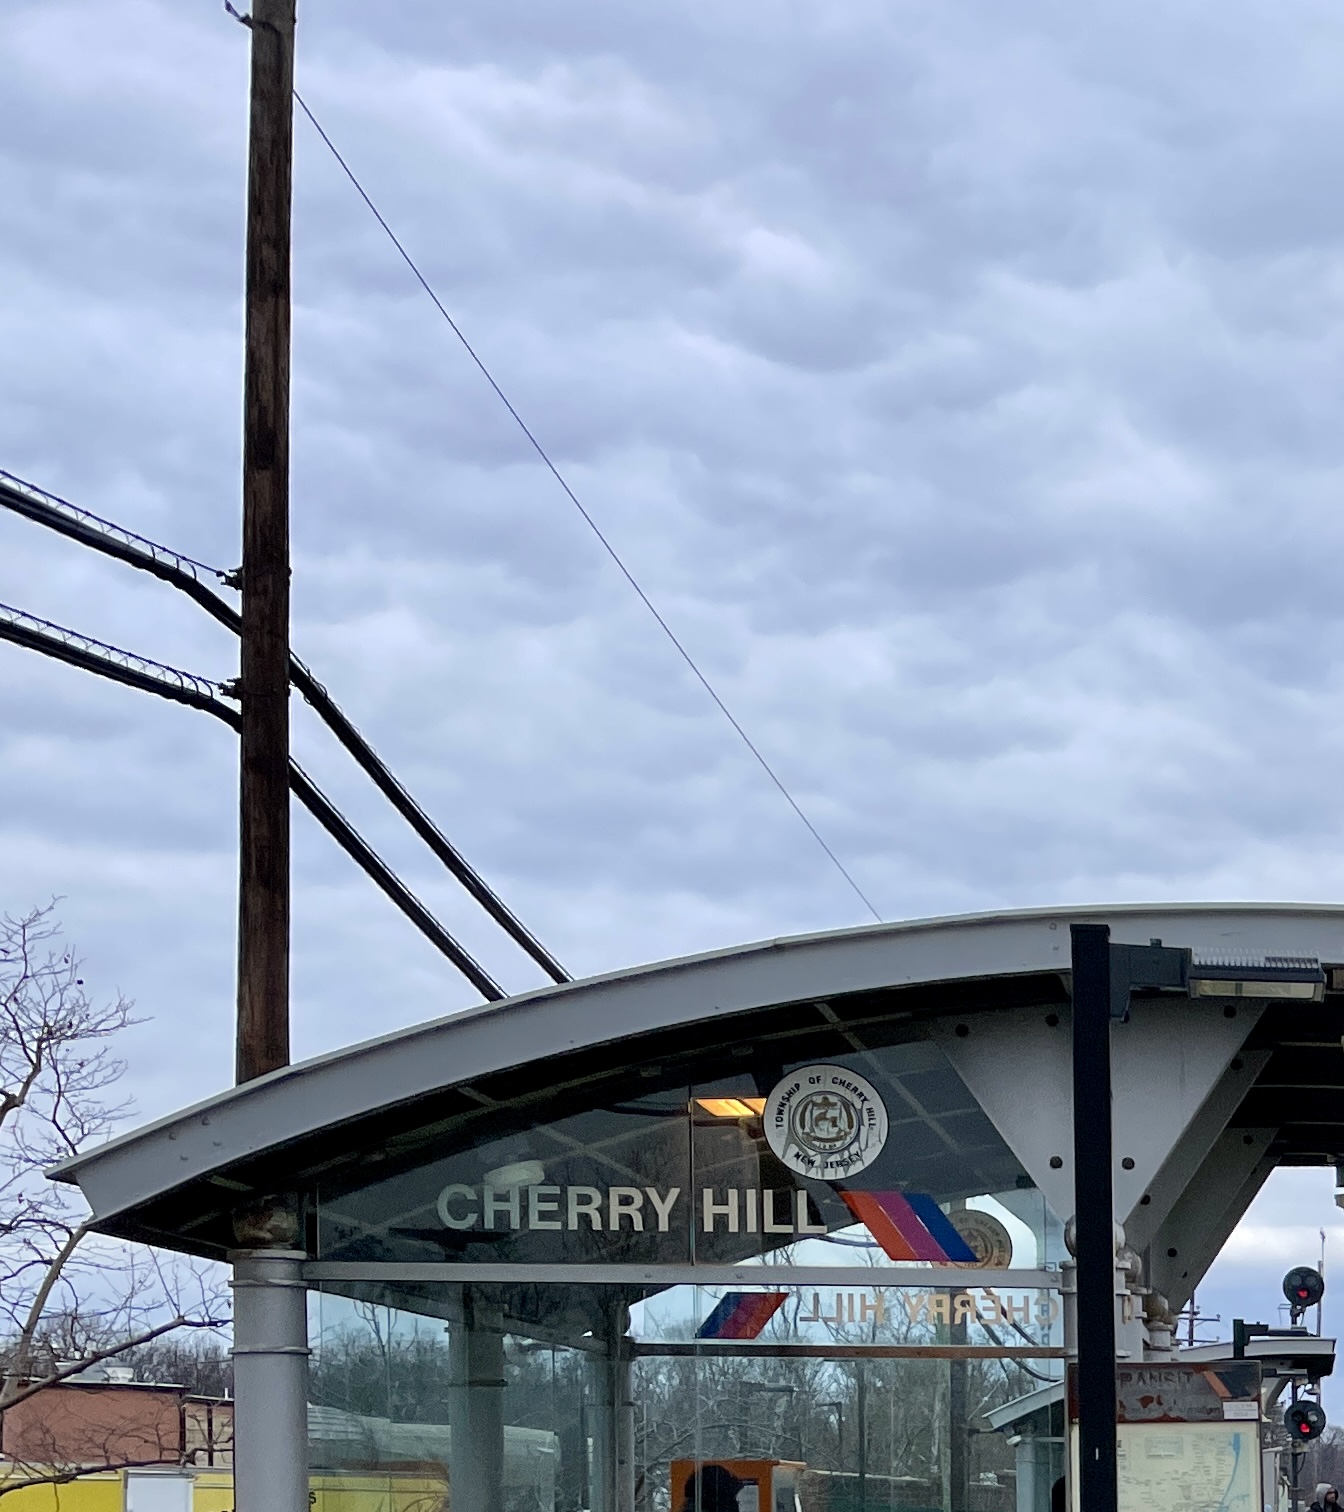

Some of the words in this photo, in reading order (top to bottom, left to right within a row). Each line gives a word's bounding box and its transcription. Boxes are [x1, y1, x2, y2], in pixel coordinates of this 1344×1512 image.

[775, 1083, 801, 1129] TOWNSHIP
[808, 1075, 822, 1085] OF
[831, 1077, 871, 1102] CHERRY
[793, 1151, 816, 1167] NEW
[824, 1151, 861, 1169] JERSEY
[436, 1184, 680, 1232] CHERRY
[702, 1188, 828, 1234] HILL
